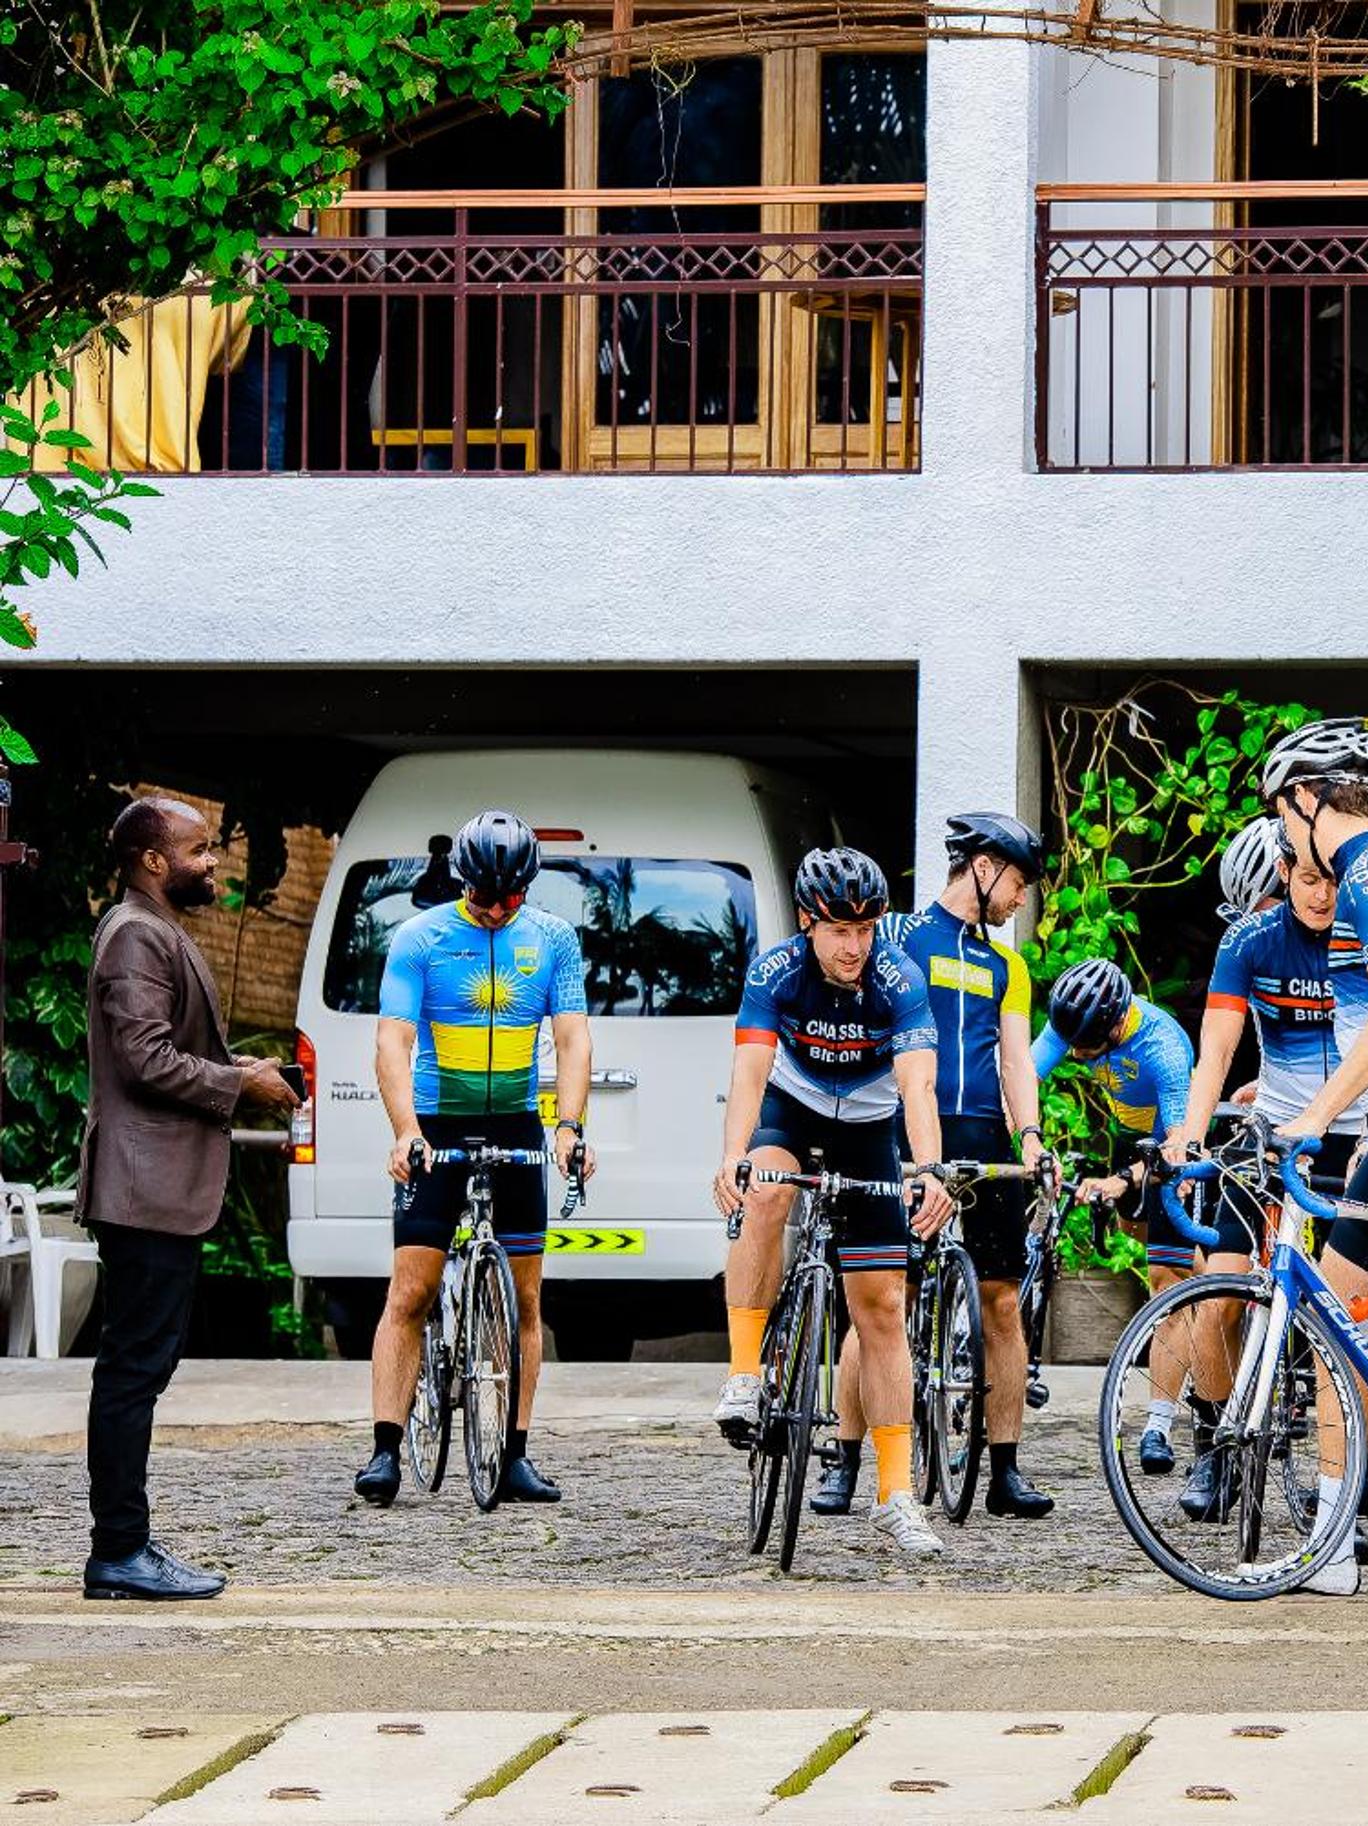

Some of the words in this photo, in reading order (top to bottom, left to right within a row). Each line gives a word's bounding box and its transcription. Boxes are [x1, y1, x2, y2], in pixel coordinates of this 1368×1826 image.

[1287, 977, 1335, 999] CHAS
[806, 1019, 866, 1041] CHASSE
[809, 1046, 863, 1063] BIDON
